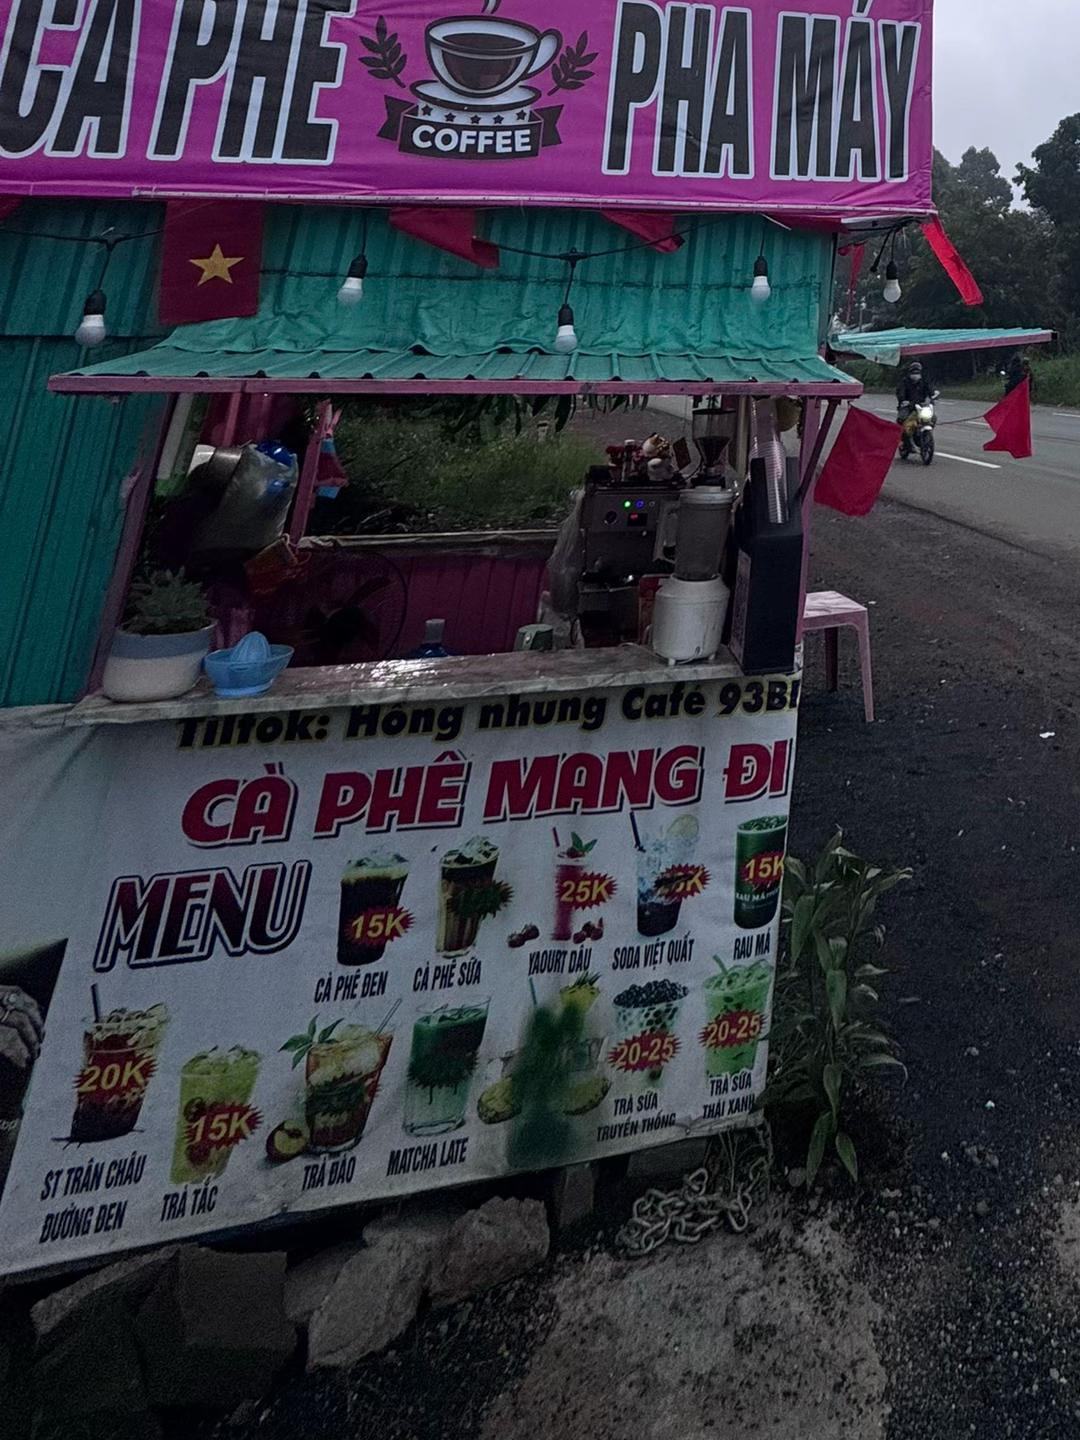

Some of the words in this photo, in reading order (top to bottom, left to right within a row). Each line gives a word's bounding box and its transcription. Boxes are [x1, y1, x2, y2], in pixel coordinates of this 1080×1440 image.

[412, 125, 532, 153] COFFEE
[478, 693, 607, 730] nhung
[621, 682, 706, 720] Café
[181, 762, 298, 849] CÀ
[313, 750, 472, 839] PHÊ
[482, 745, 705, 824] MANG
[722, 738, 792, 804] ĐI
[560, 877, 609, 903] 25K
[93, 860, 312, 973] MENU
[349, 910, 407, 942] 15K
[612, 946, 641, 971] SODA
[642, 940, 669, 972] VIỆT
[733, 934, 754, 960] RAU
[755, 927, 771, 958] MÁ
[412, 960, 430, 992] CÀ
[431, 958, 457, 991] PHÊ
[458, 950, 482, 987] SỮA
[528, 950, 568, 976] YAOURT
[314, 971, 333, 1003] CÀ
[333, 968, 362, 1000] PHÊ
[360, 970, 389, 999] ĐEN
[706, 1013, 762, 1044] 20-25
[614, 1036, 676, 1067] 20-25
[78, 1059, 149, 1094] 20K
[710, 1072, 729, 1097] TRÀ
[613, 1095, 633, 1117] TRÀ
[702, 1098, 726, 1120] THÁI
[186, 1111, 252, 1145] 15K
[302, 1157, 327, 1192] TRÀ
[327, 1153, 356, 1186] ĐÀO
[386, 1141, 438, 1177] MATCHA
[440, 1137, 469, 1168] LATE
[40, 1168, 64, 1201] ST
[105, 1150, 148, 1190] CHÂU
[93, 1201, 128, 1234] ĐEN
[160, 1185, 189, 1222] TRÀ
